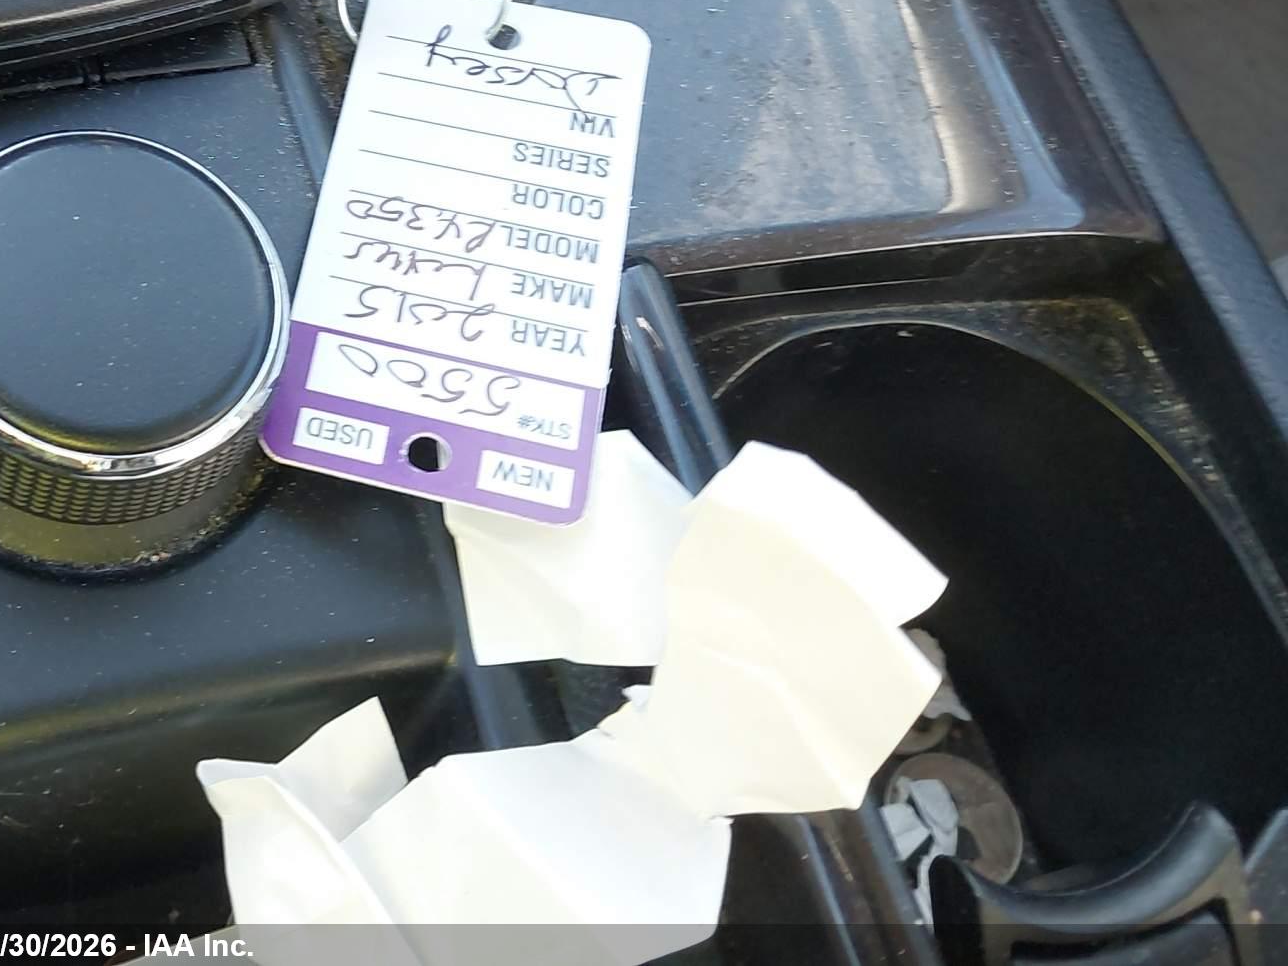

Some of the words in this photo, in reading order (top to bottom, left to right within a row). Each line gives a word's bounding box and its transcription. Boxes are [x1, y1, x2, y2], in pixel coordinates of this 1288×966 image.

[568, 112, 616, 139] VIN
[513, 142, 611, 178] SERIES
[511, 183, 605, 219] COLOR
[501, 224, 600, 263] MODEL
[511, 272, 593, 309] MAKE
[343, 285, 495, 342] 2015
[510, 321, 586, 356] YEAR
[338, 343, 521, 418] 5500
[305, 416, 373, 450] USED
[517, 415, 573, 441] STK#
[493, 460, 554, 492] NEW
